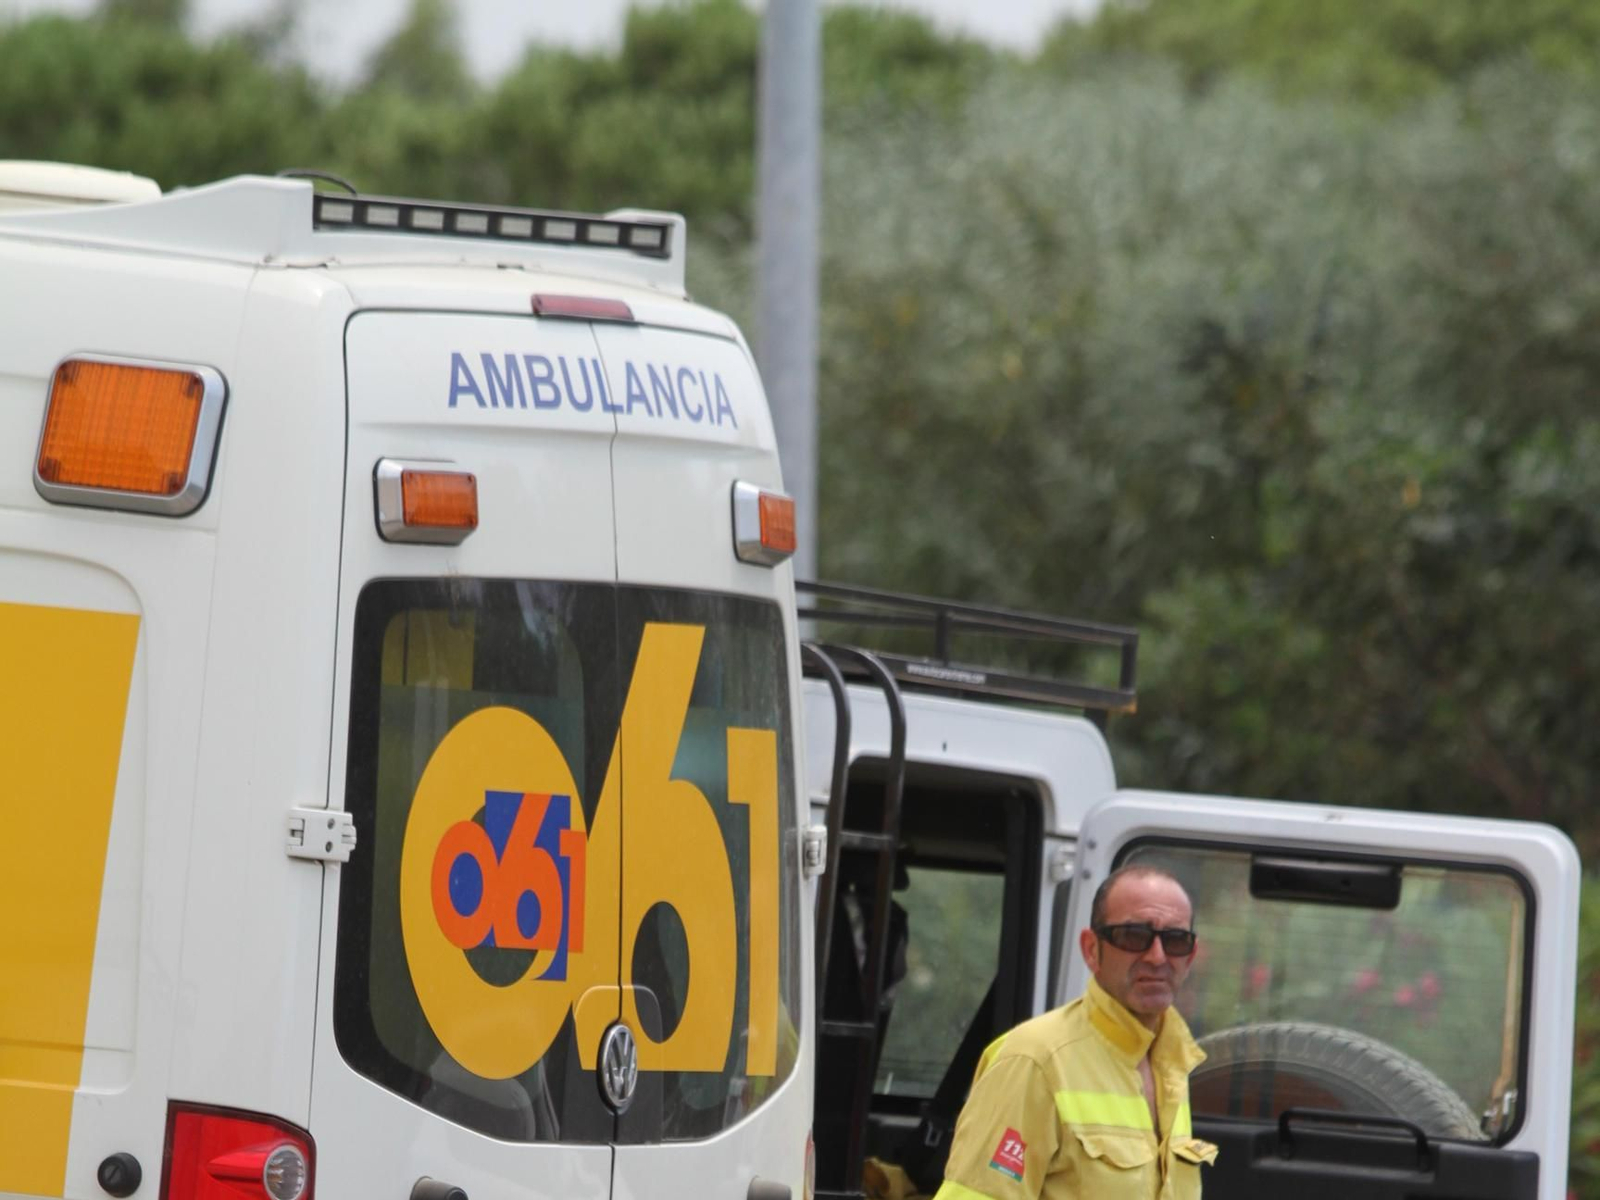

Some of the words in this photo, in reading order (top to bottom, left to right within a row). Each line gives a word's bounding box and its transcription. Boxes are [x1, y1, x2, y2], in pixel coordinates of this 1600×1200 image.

[447, 352, 738, 430] AMBULANCIA
[400, 621, 780, 1081] 061
[430, 792, 587, 954] 061
